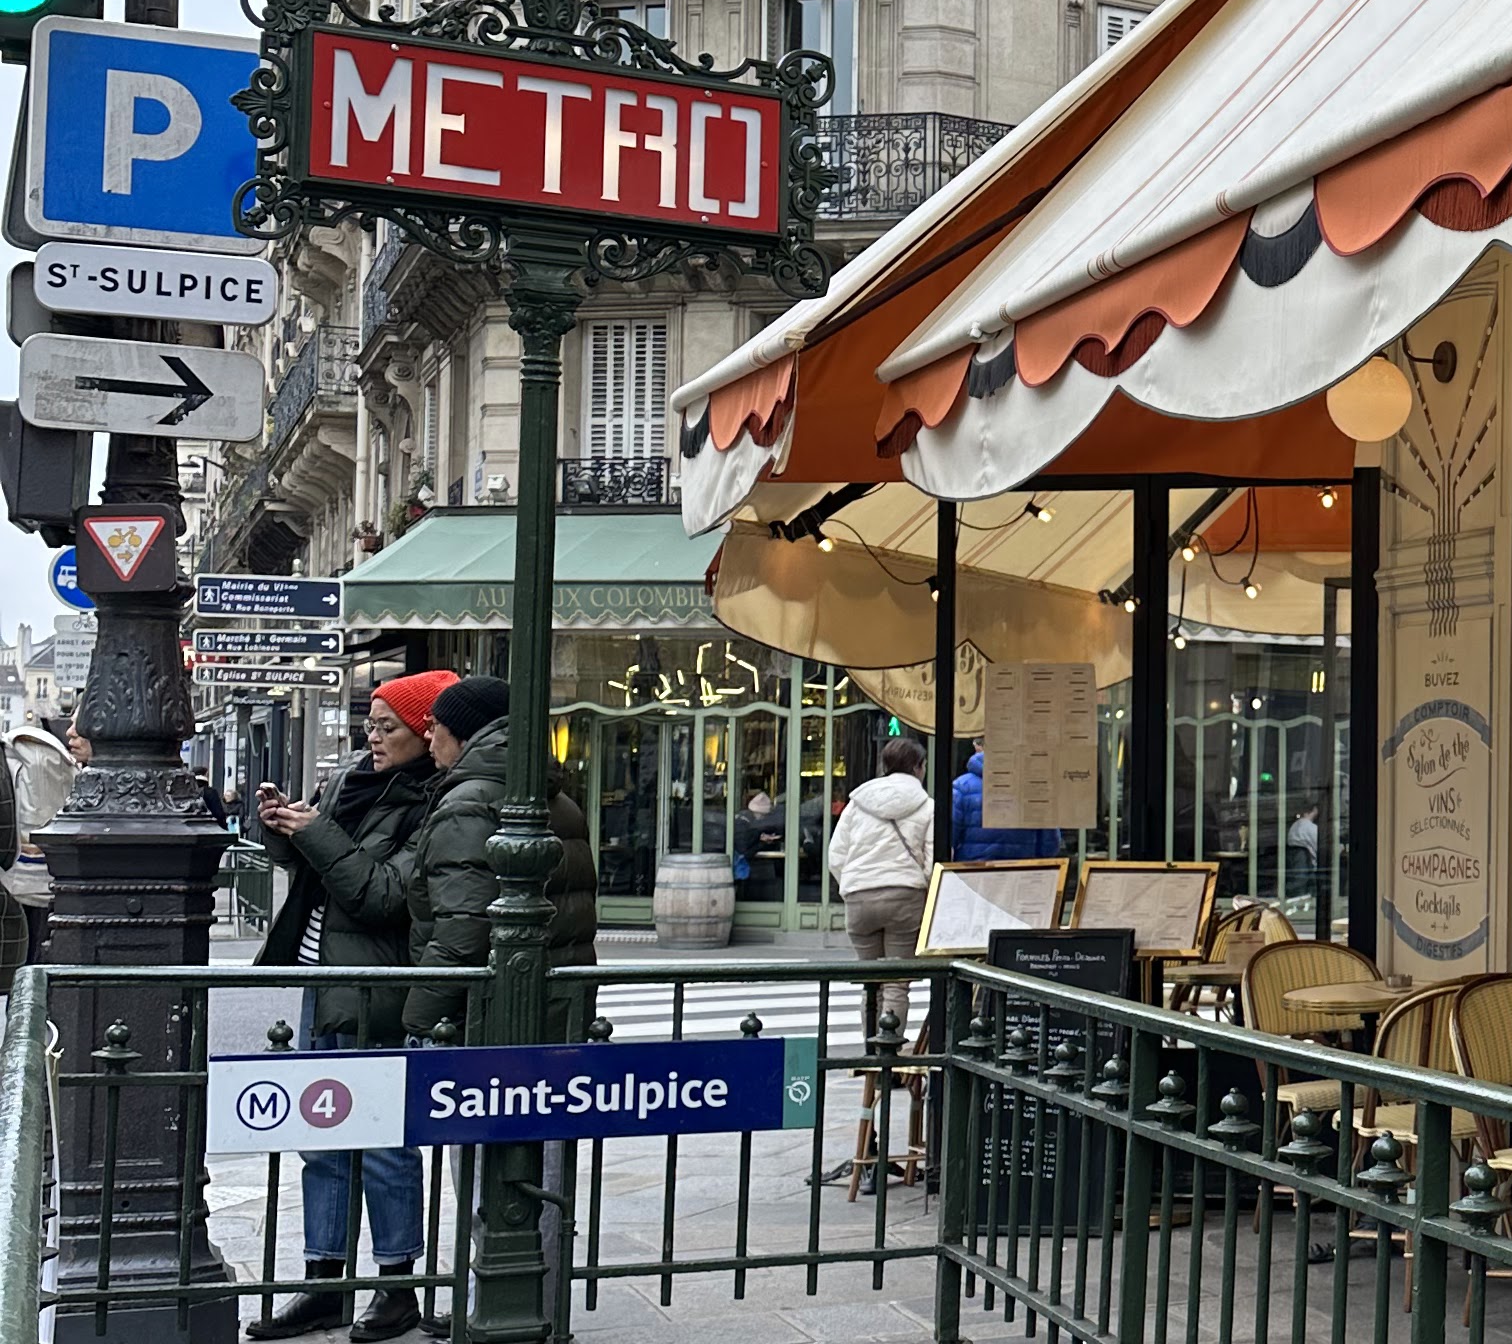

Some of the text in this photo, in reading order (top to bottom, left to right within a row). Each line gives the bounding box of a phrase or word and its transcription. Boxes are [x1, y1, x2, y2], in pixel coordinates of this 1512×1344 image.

[102, 68, 203, 196] P
[329, 47, 762, 220] METRO
[221, 581, 254, 591] Mairie
[257, 582, 270, 591] du
[221, 592, 289, 603] Commissariat
[476, 587, 507, 607] AU
[590, 587, 709, 607] COLOMBIE
[269, 634, 307, 644] Germain
[265, 673, 305, 682] SULPICE
[1424, 672, 1460, 687] BUVEZ
[1414, 702, 1470, 723] COMPTOIR
[1407, 732, 1470, 783] Salon de thé
[1429, 787, 1456, 814] VINS
[1401, 853, 1481, 880] CHAMPAGNES
[1415, 889, 1461, 921] Cocktails
[248, 1091, 279, 1120] M
[310, 1087, 336, 1119] 4
[429, 1071, 729, 1119] Saint-Sulpice
